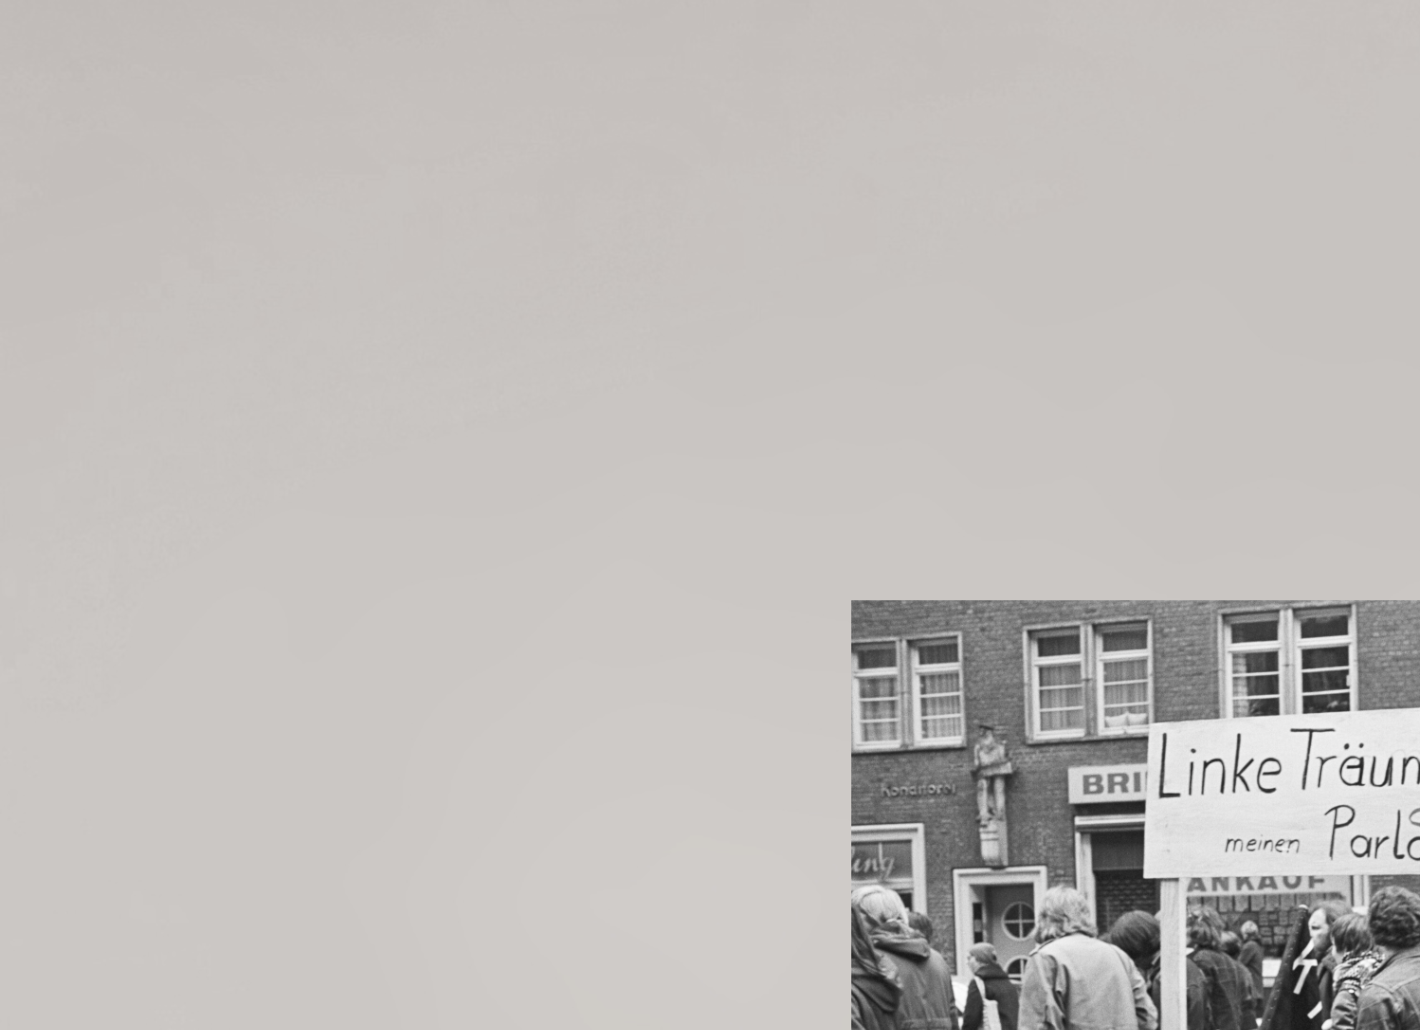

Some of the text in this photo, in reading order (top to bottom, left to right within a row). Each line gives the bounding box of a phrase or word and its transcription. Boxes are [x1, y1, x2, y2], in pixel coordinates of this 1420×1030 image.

[1157, 731, 1284, 799] Linke
[1082, 771, 1147, 795] BRI
[1223, 836, 1302, 855] meinen
